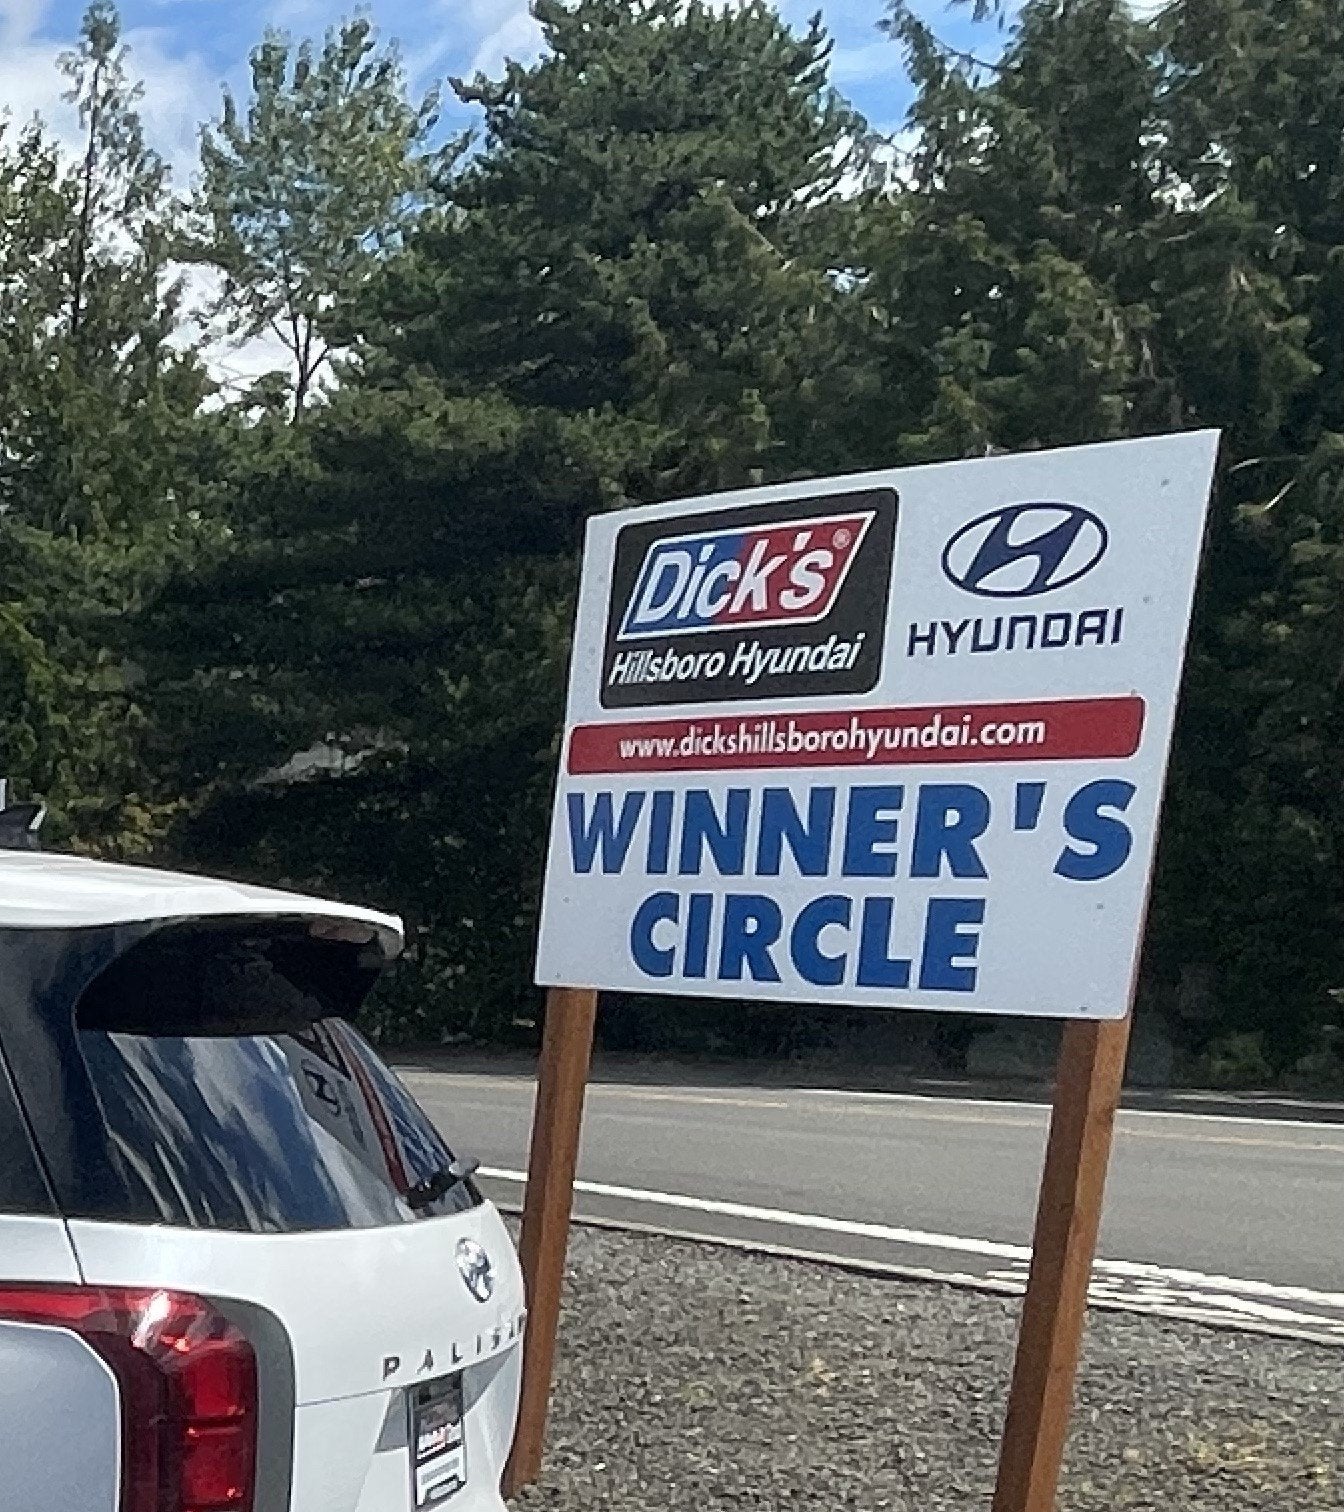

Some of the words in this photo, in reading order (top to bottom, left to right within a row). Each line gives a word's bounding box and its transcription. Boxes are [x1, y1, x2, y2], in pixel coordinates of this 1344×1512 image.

[633, 531, 833, 623] Dick's
[608, 646, 726, 686] Hillsboro
[728, 632, 866, 686] Hyundai
[907, 607, 1124, 658] HYUNDAI
[619, 714, 1046, 758] www.dickshillsborohyundai.com
[566, 778, 1138, 882] WINNER'S
[629, 890, 987, 993] CIRCLE
